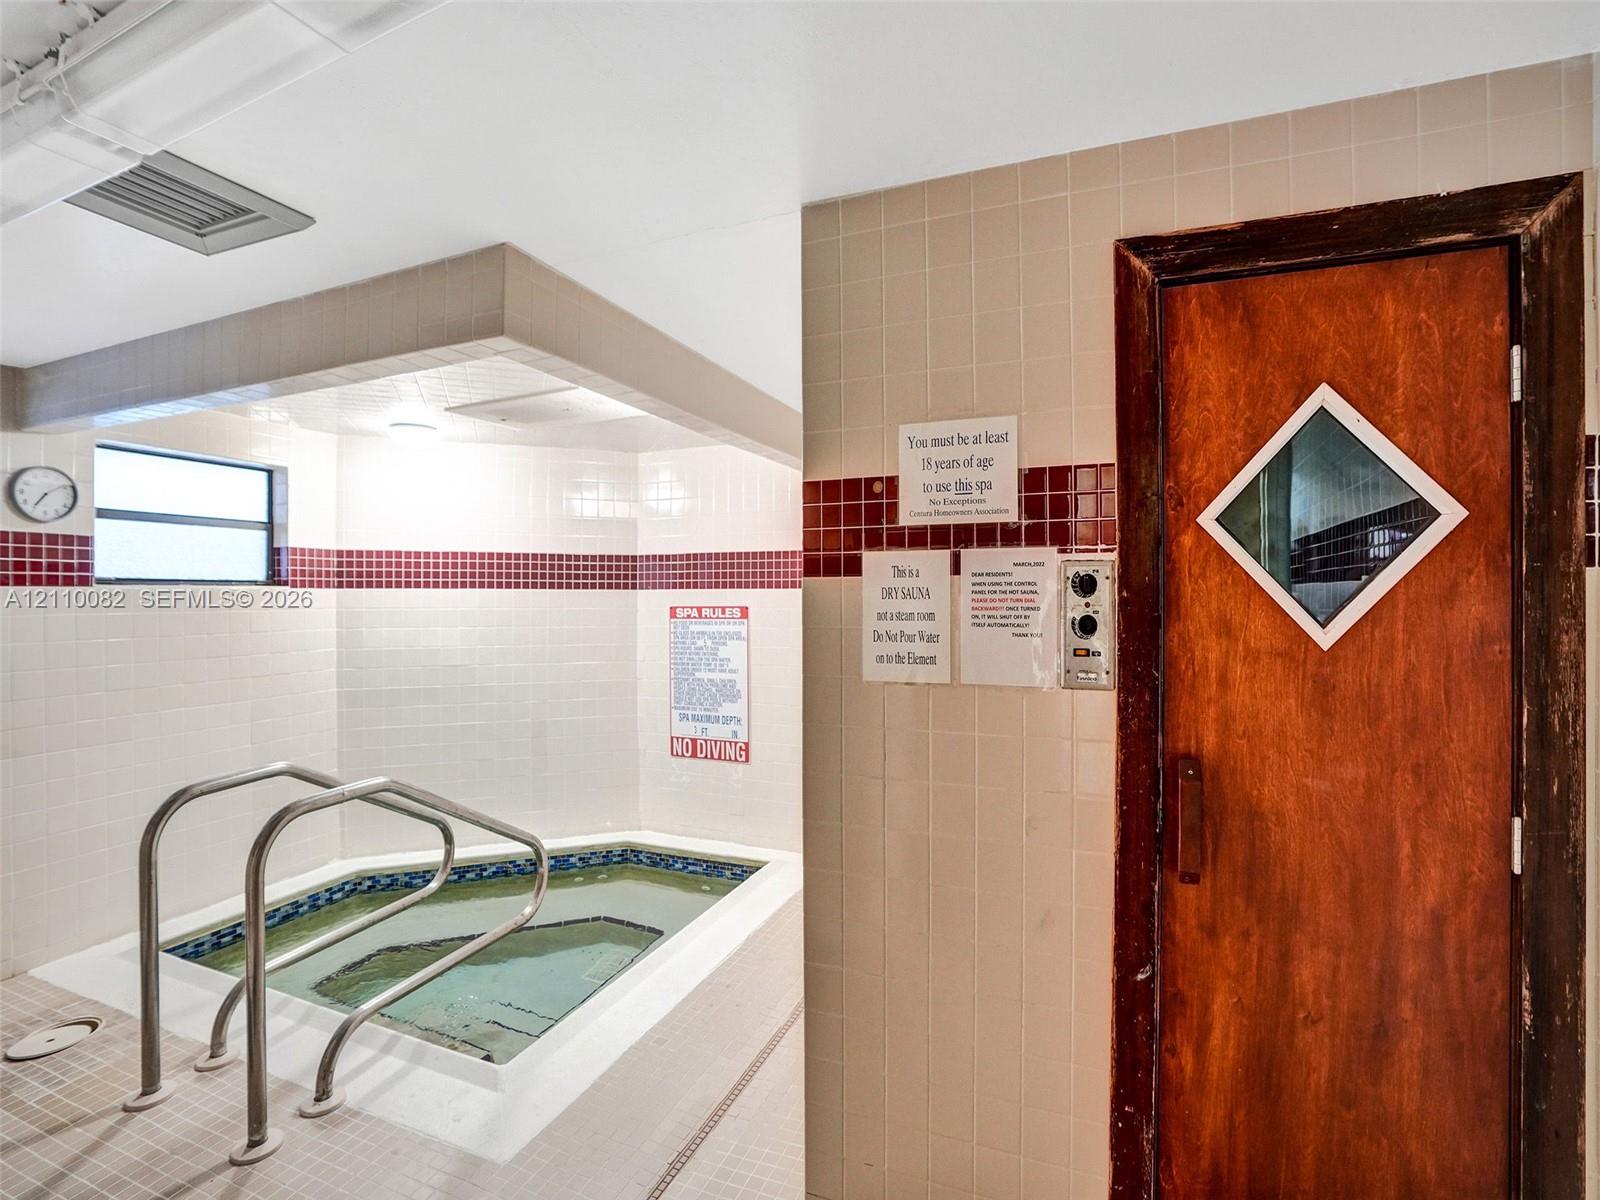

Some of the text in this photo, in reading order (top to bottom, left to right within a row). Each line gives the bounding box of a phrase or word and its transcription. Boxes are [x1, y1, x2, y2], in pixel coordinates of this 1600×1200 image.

[908, 431, 1008, 448] You must be at least
[922, 454, 994, 473] 18 years of age
[923, 478, 992, 494] to use this spa
[943, 497, 986, 506] Exceptions
[974, 507, 1009, 515] Association
[892, 565, 919, 578] This is a
[881, 587, 930, 599] DRY SAUNA
[676, 608, 741, 618] SPA RULES
[877, 611, 888, 621] not
[895, 611, 914, 621] steam
[873, 630, 940, 643] Do Not Pour Water
[876, 652, 936, 665] on to the Element
[679, 713, 689, 722] SPA
[691, 713, 720, 724] MAXIMUM
[672, 738, 746, 762] NO DIVING
